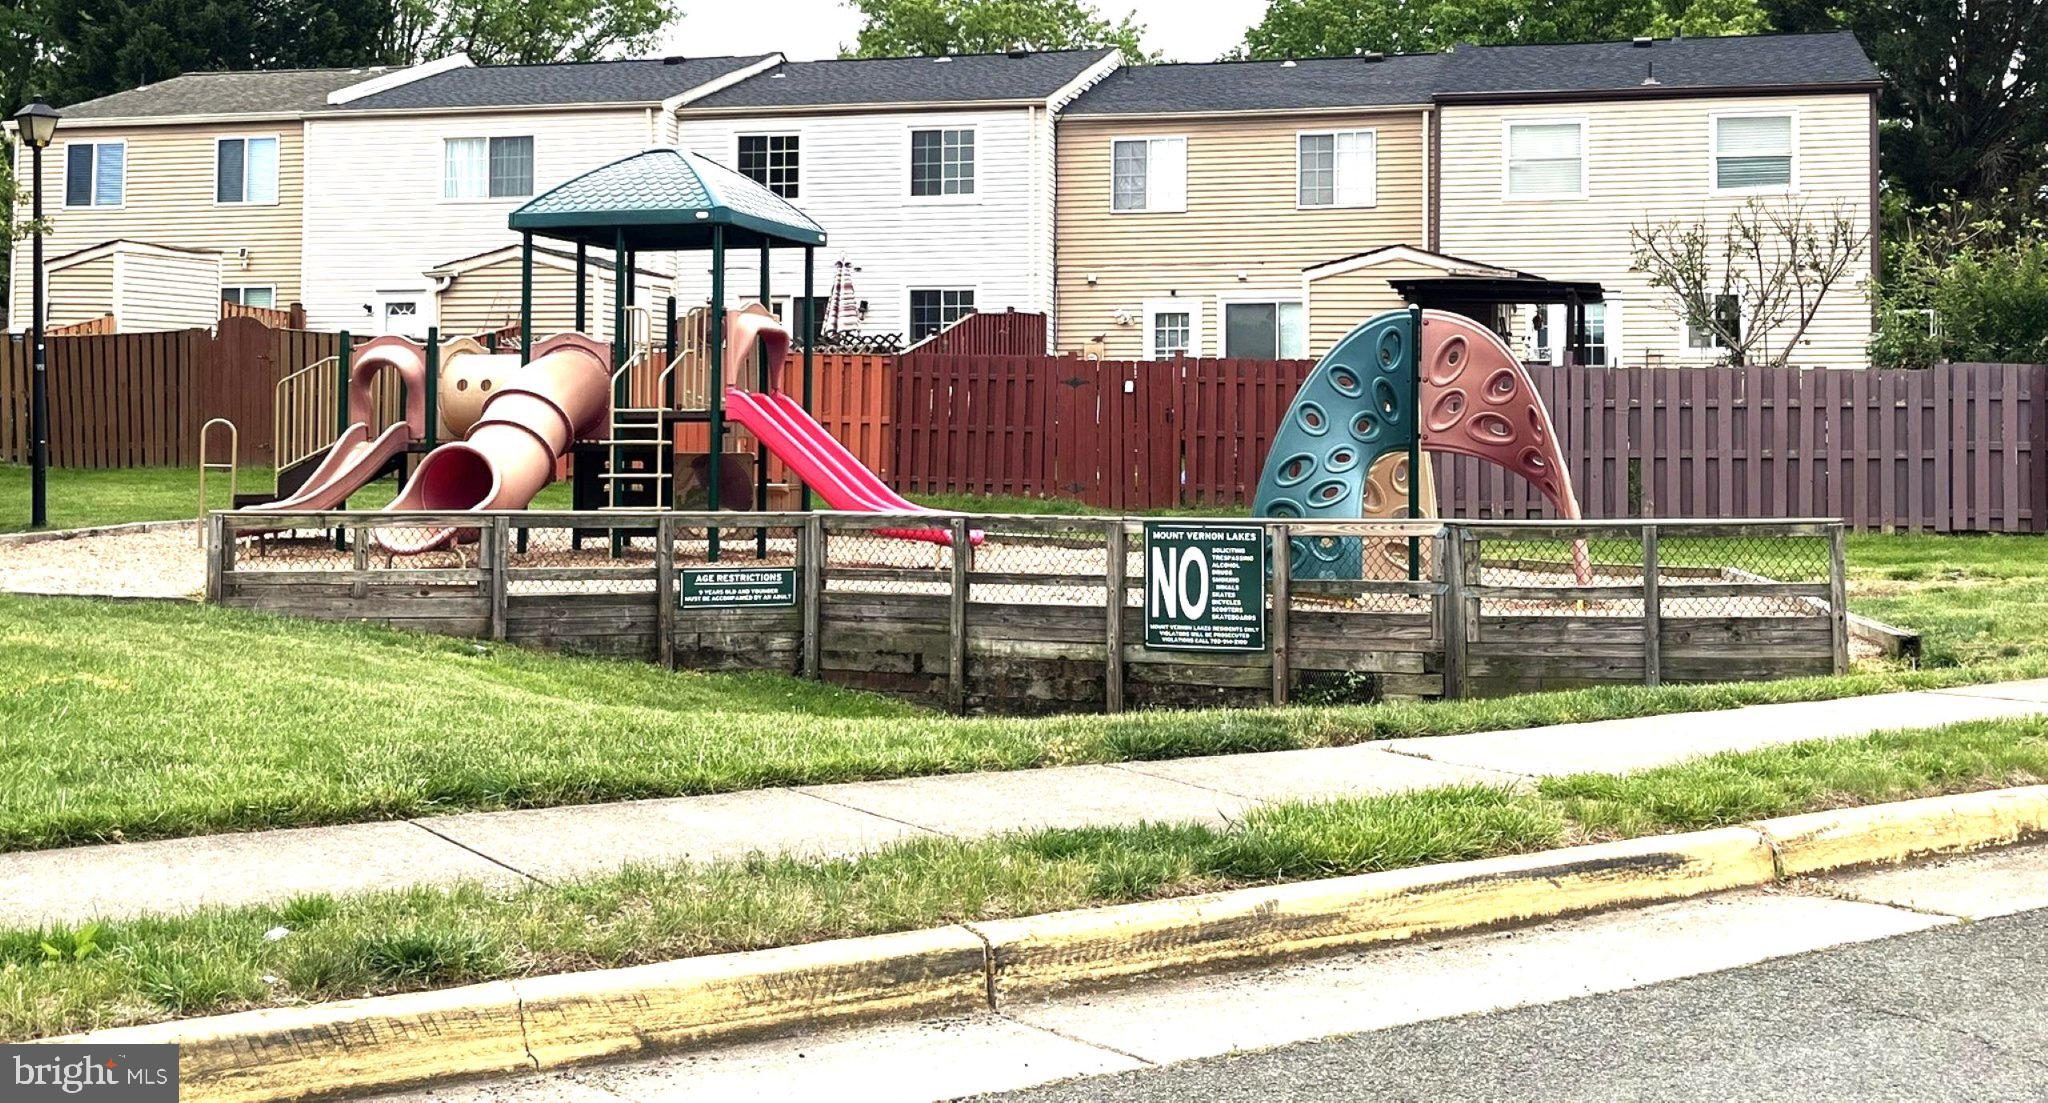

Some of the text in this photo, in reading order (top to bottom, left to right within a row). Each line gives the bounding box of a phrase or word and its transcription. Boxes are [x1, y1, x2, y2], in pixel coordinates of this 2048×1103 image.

[1152, 532, 1256, 541] MOUNT VERNON LAKES
[695, 573, 783, 582] AGE RESTRICTIONS
[1152, 546, 1209, 620] NO
